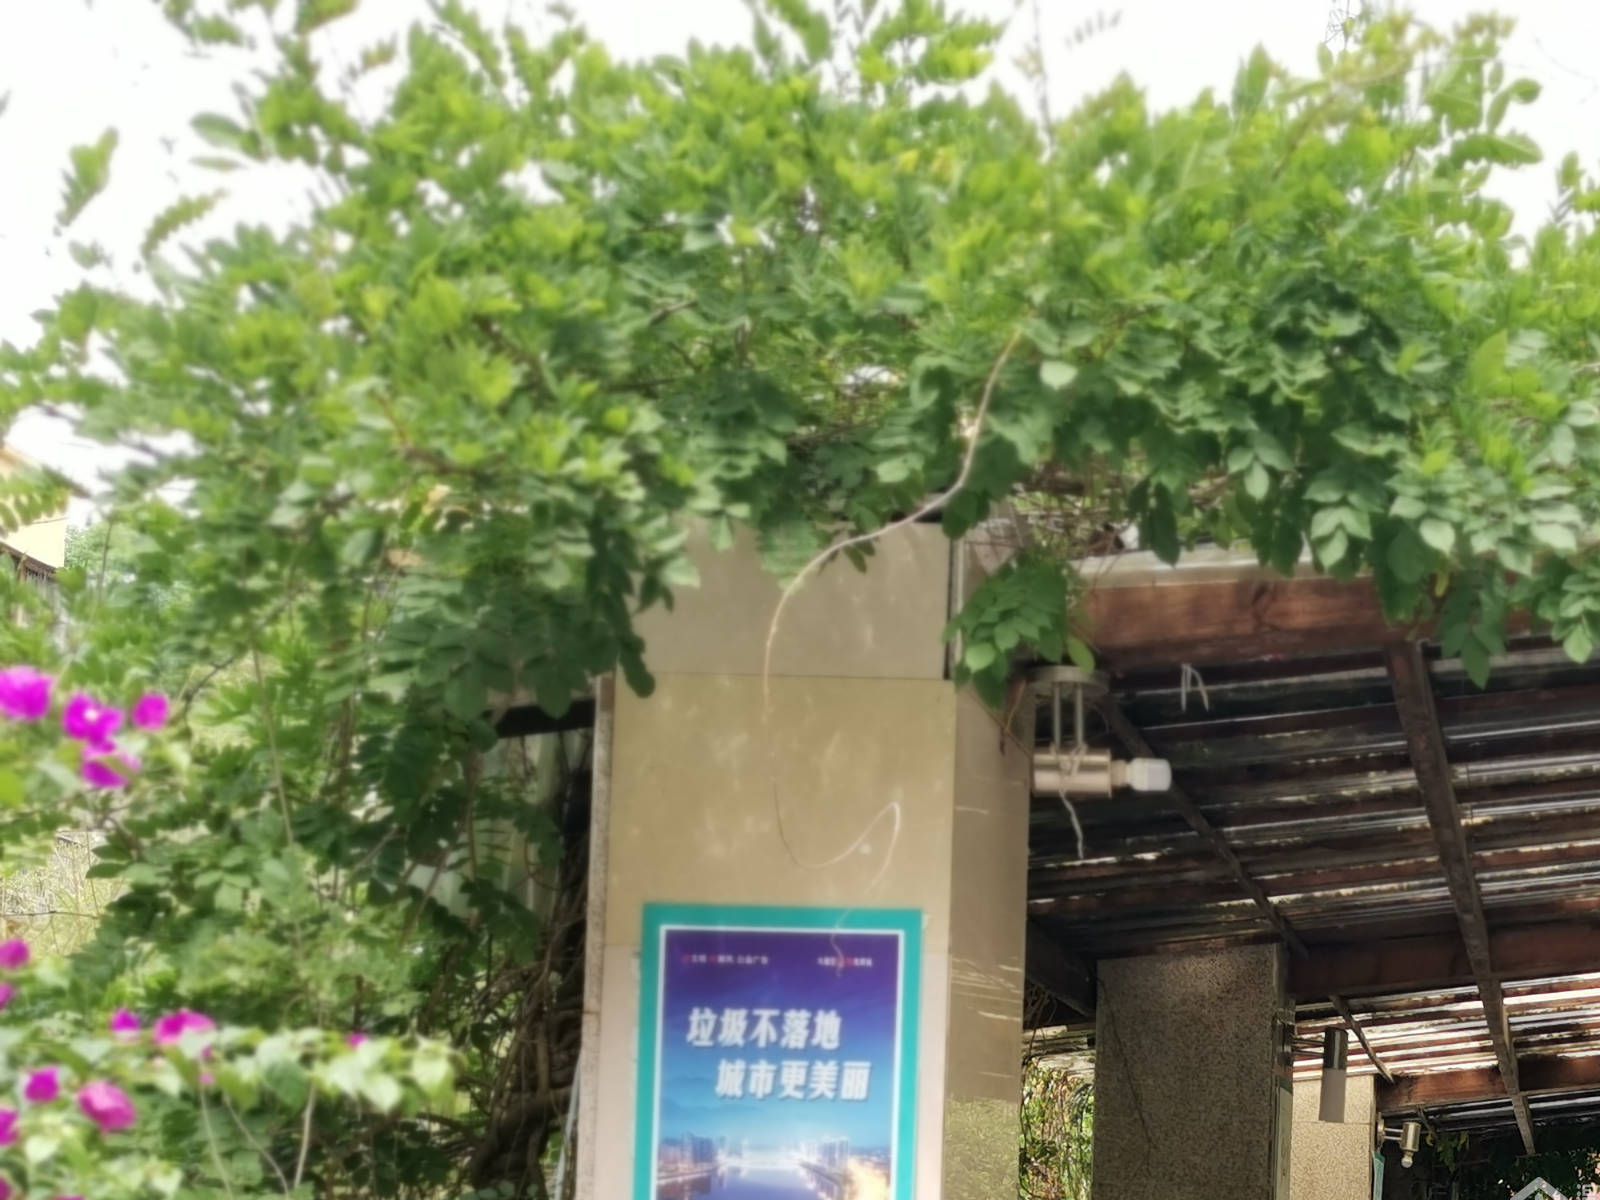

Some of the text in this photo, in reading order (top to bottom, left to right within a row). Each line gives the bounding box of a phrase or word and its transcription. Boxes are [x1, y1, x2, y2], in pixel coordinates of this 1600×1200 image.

[687, 1007, 842, 1049] 垃圾不落地
[715, 1059, 871, 1100] 城市更美丽
